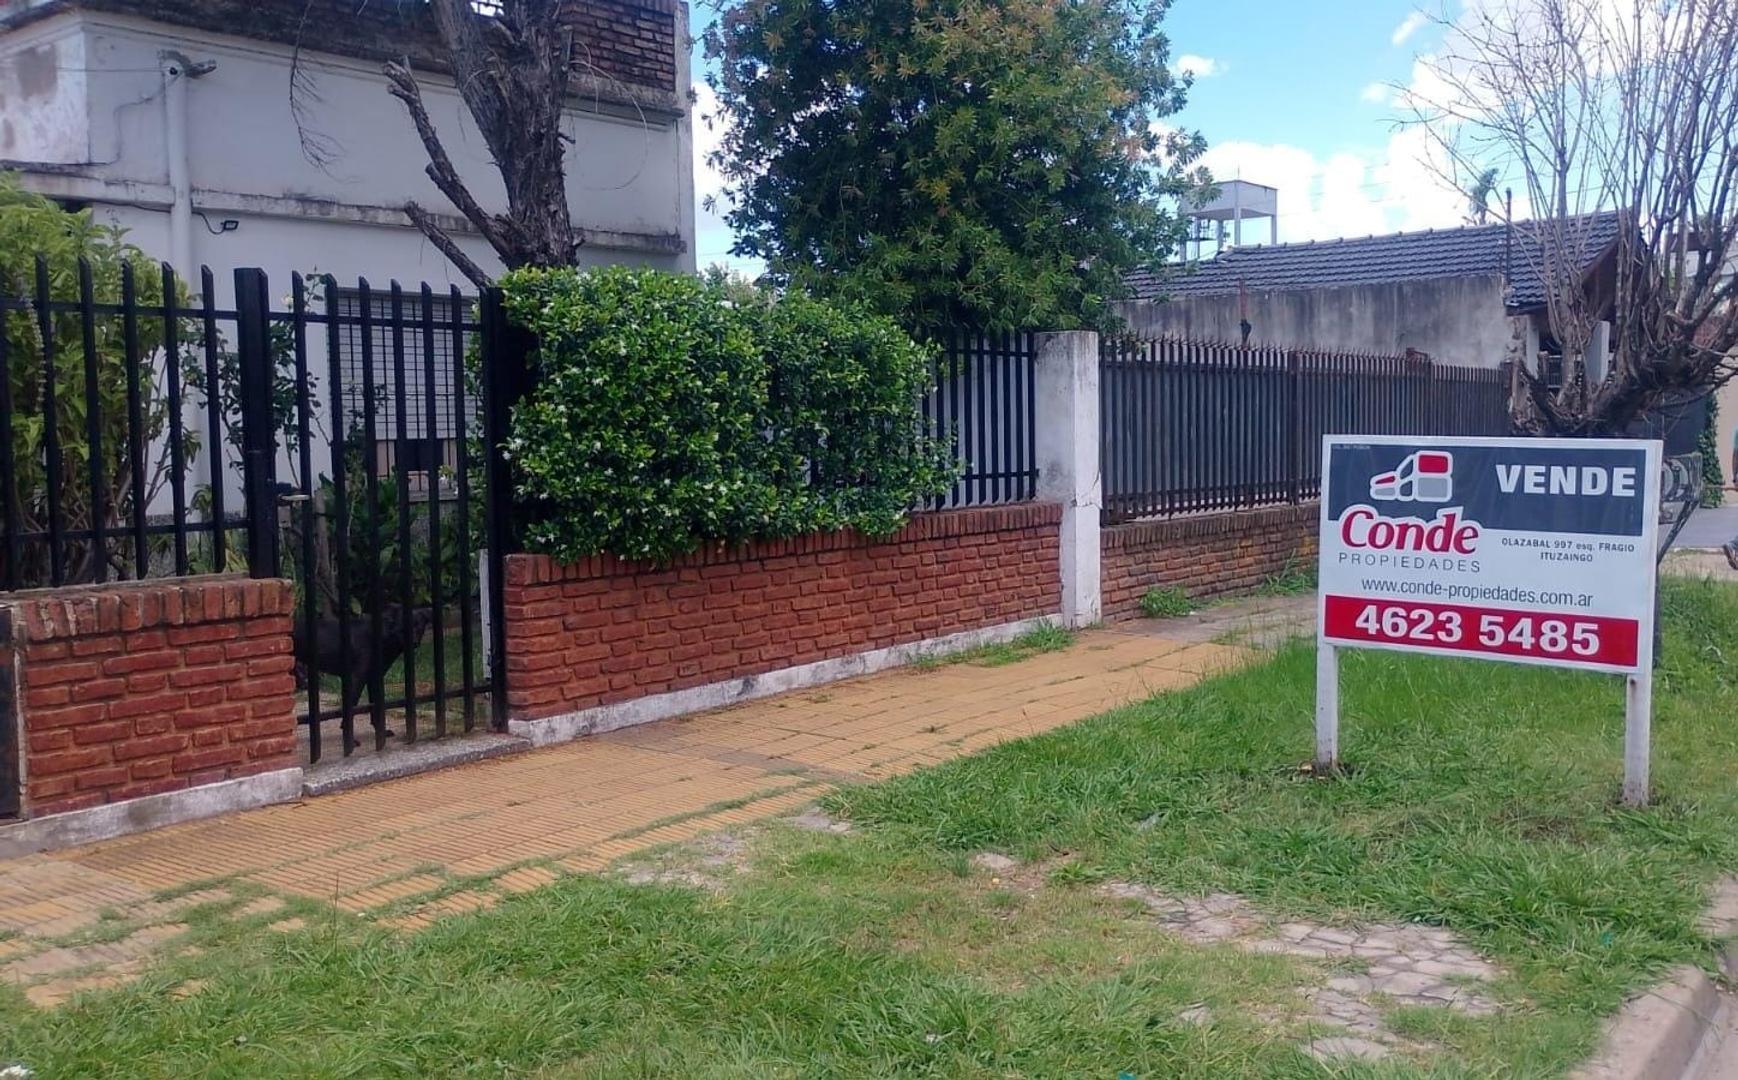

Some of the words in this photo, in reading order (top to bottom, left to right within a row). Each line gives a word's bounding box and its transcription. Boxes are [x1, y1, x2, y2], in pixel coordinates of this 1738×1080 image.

[1495, 464, 1636, 497] VENDE
[1342, 510, 1479, 554] Conde
[1501, 537, 1551, 549] OLAZABAL
[1554, 540, 1573, 550] 997
[1576, 543, 1595, 552] esq.
[1599, 542, 1635, 552] FRAGIO
[1338, 552, 1481, 573] PROPIEDADES
[1540, 551, 1593, 562] ITUZAINGO
[1361, 578, 1594, 607] www.conde-propiedades.com.ar
[1355, 604, 1463, 643] 4623
[1478, 614, 1600, 655] 5485
